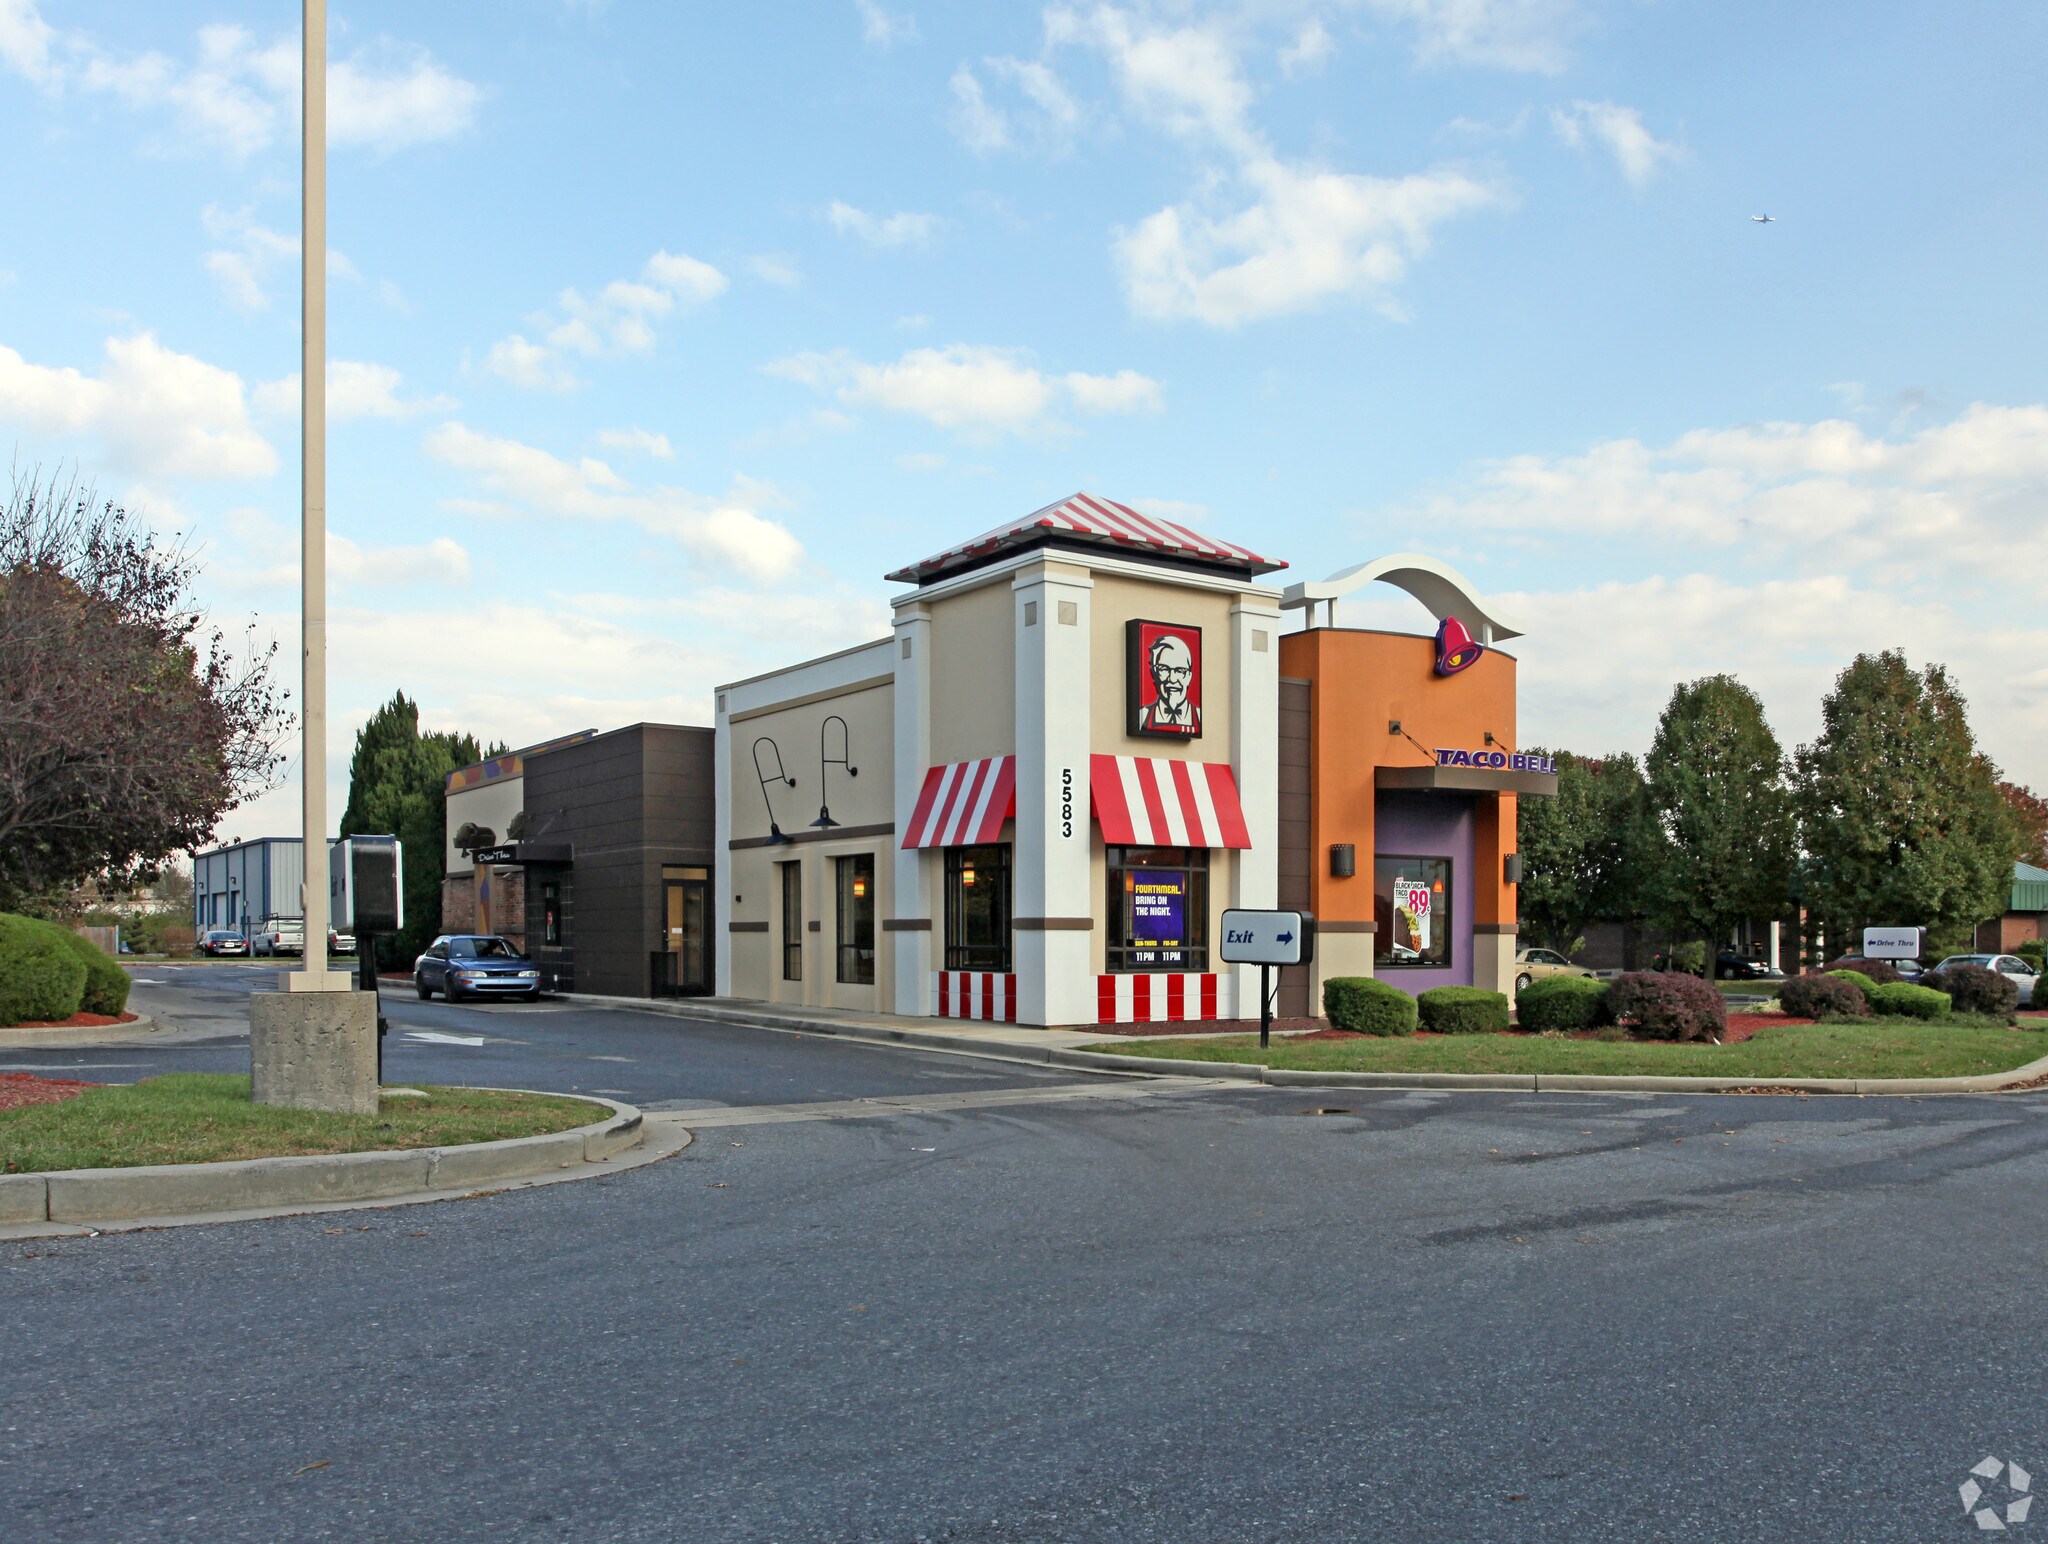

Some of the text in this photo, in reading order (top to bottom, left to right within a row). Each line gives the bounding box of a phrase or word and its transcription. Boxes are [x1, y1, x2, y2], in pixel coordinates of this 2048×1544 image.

[1435, 748, 1558, 774] TACO BELL
[1062, 768, 1072, 838] 5583
[1136, 885, 1181, 894] FOURTHMEAL.
[1136, 896, 1167, 905] BRING ON
[1136, 907, 1171, 915] THE NIGHT.
[1227, 930, 1254, 943] Exit
